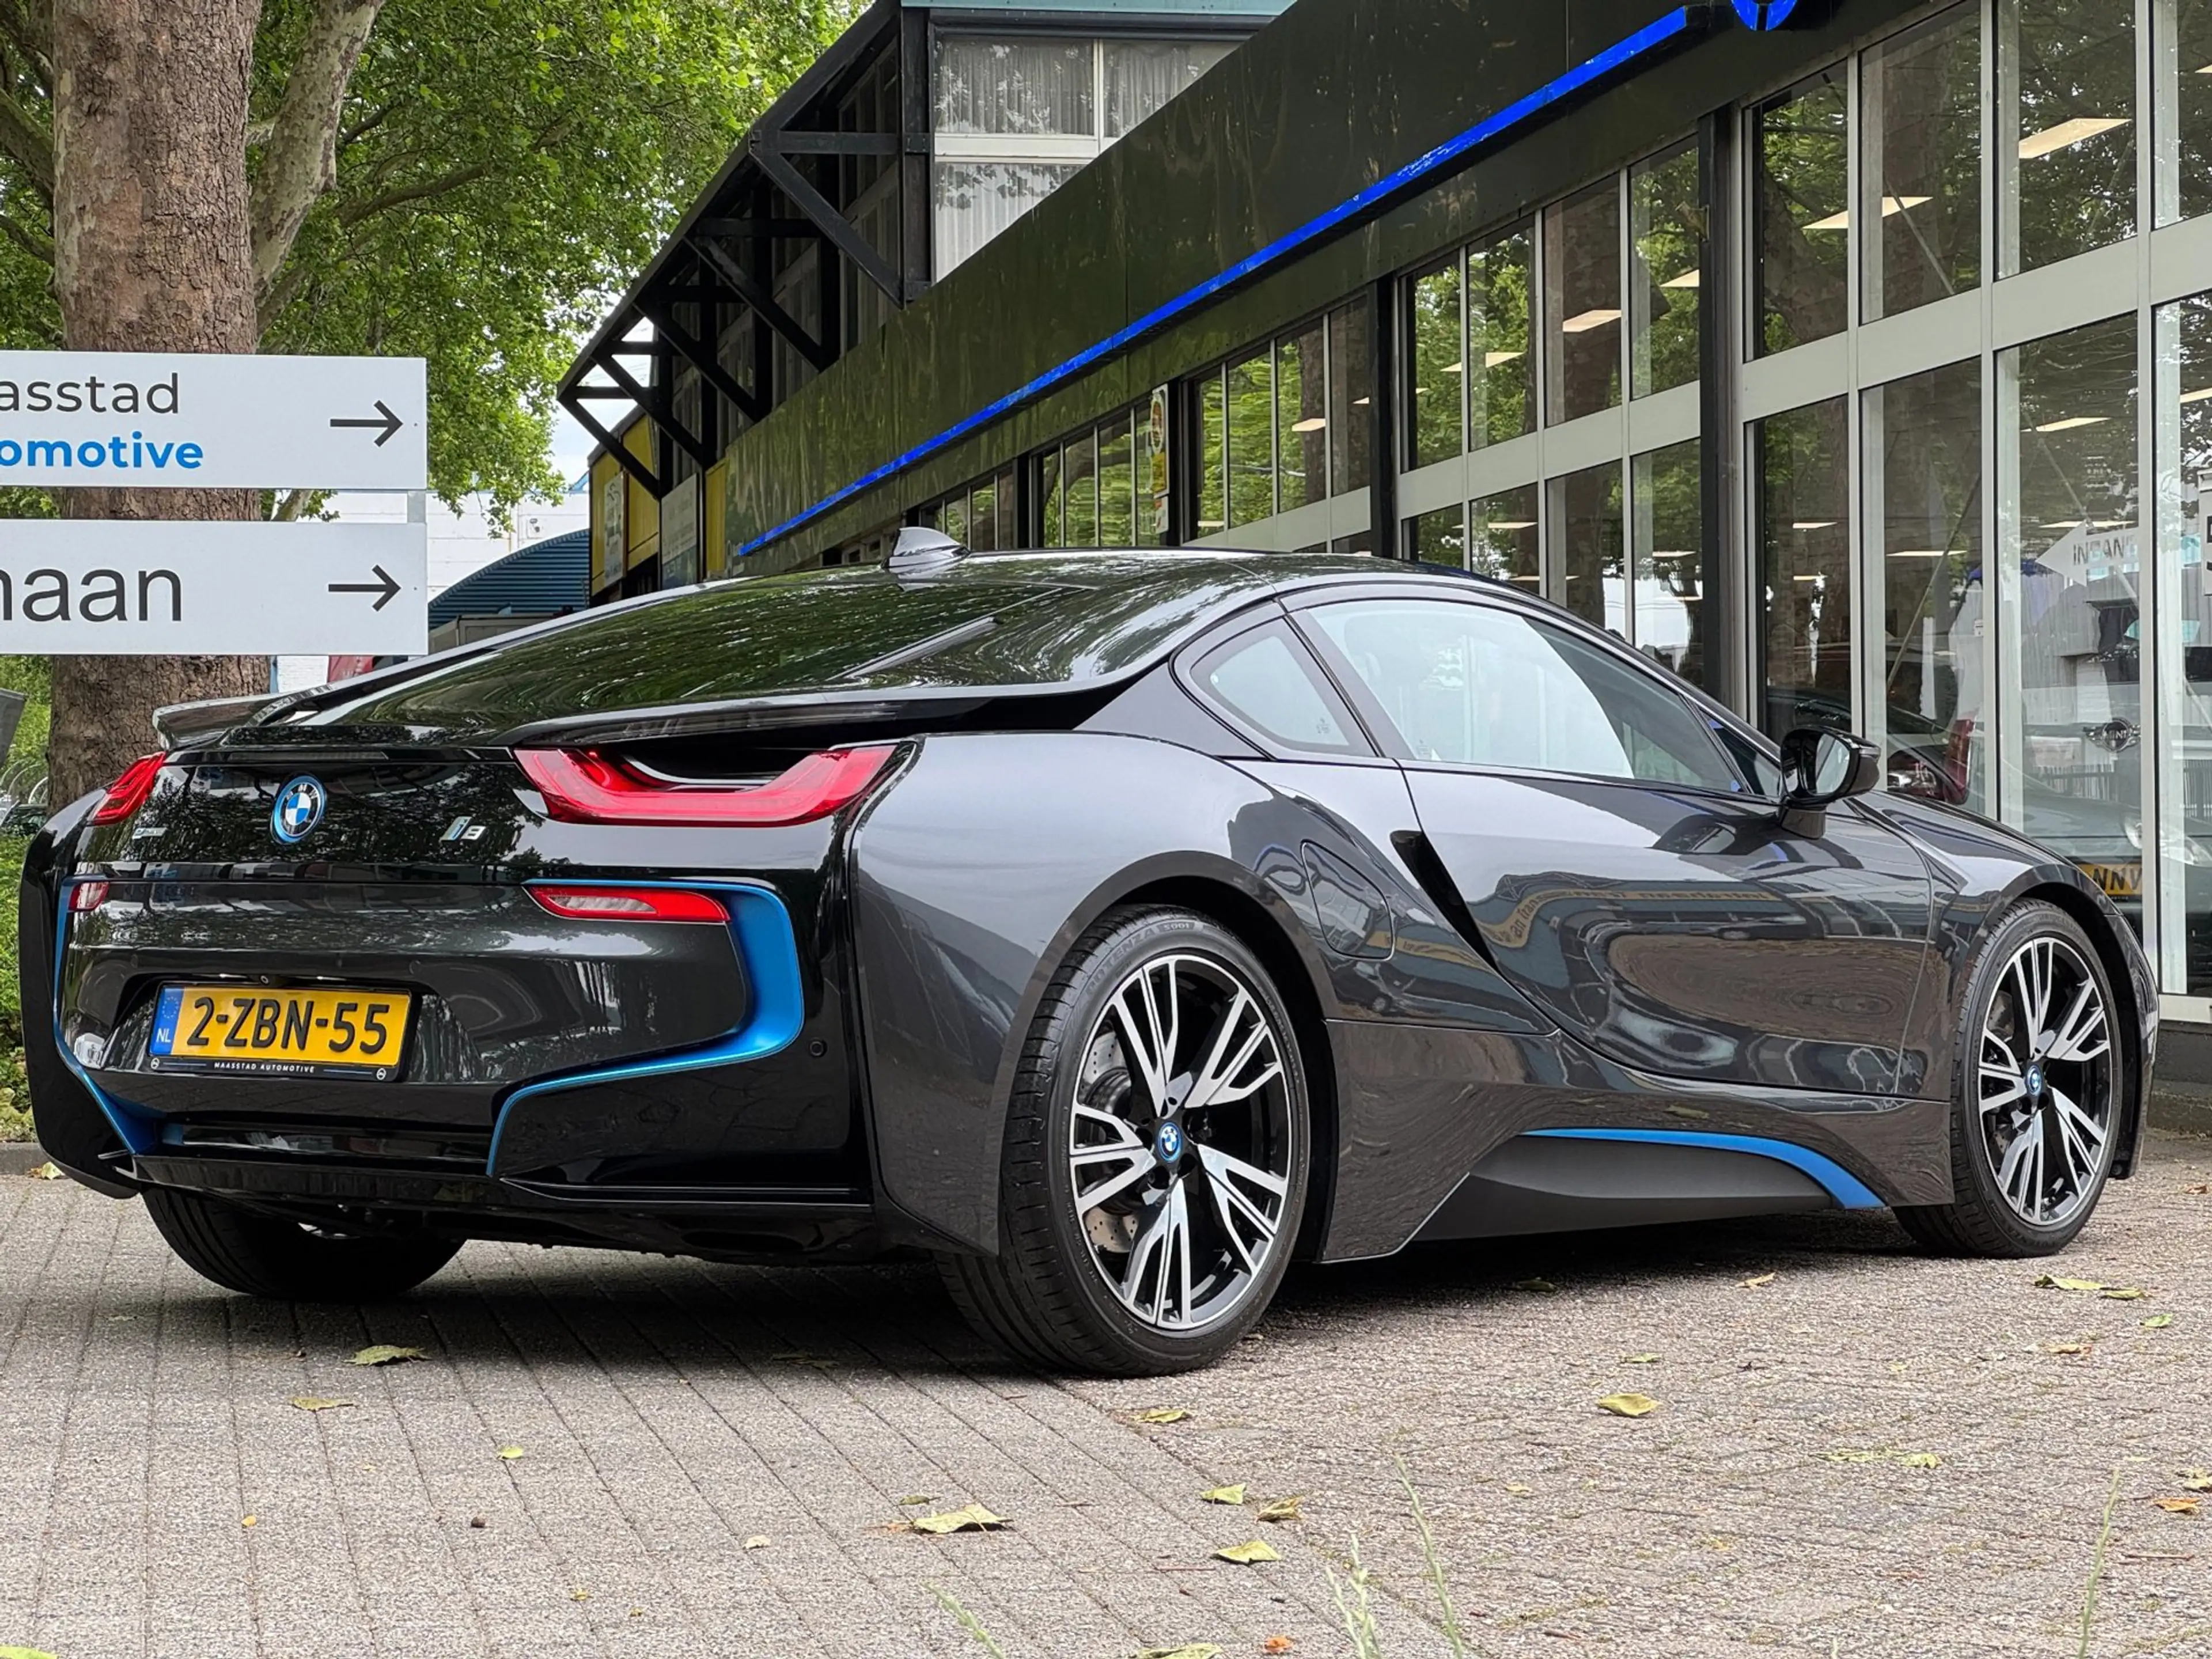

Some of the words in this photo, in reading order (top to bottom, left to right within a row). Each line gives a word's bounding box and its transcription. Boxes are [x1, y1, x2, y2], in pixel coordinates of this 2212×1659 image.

[0, 569, 182, 622] aan
[439, 816, 486, 841] i8
[156, 1027, 171, 1043] NL
[187, 997, 391, 1054] 2-ZBN-55
[214, 1062, 257, 1070] MAASSTAD
[260, 1063, 316, 1074] AUTOMOTIVE
